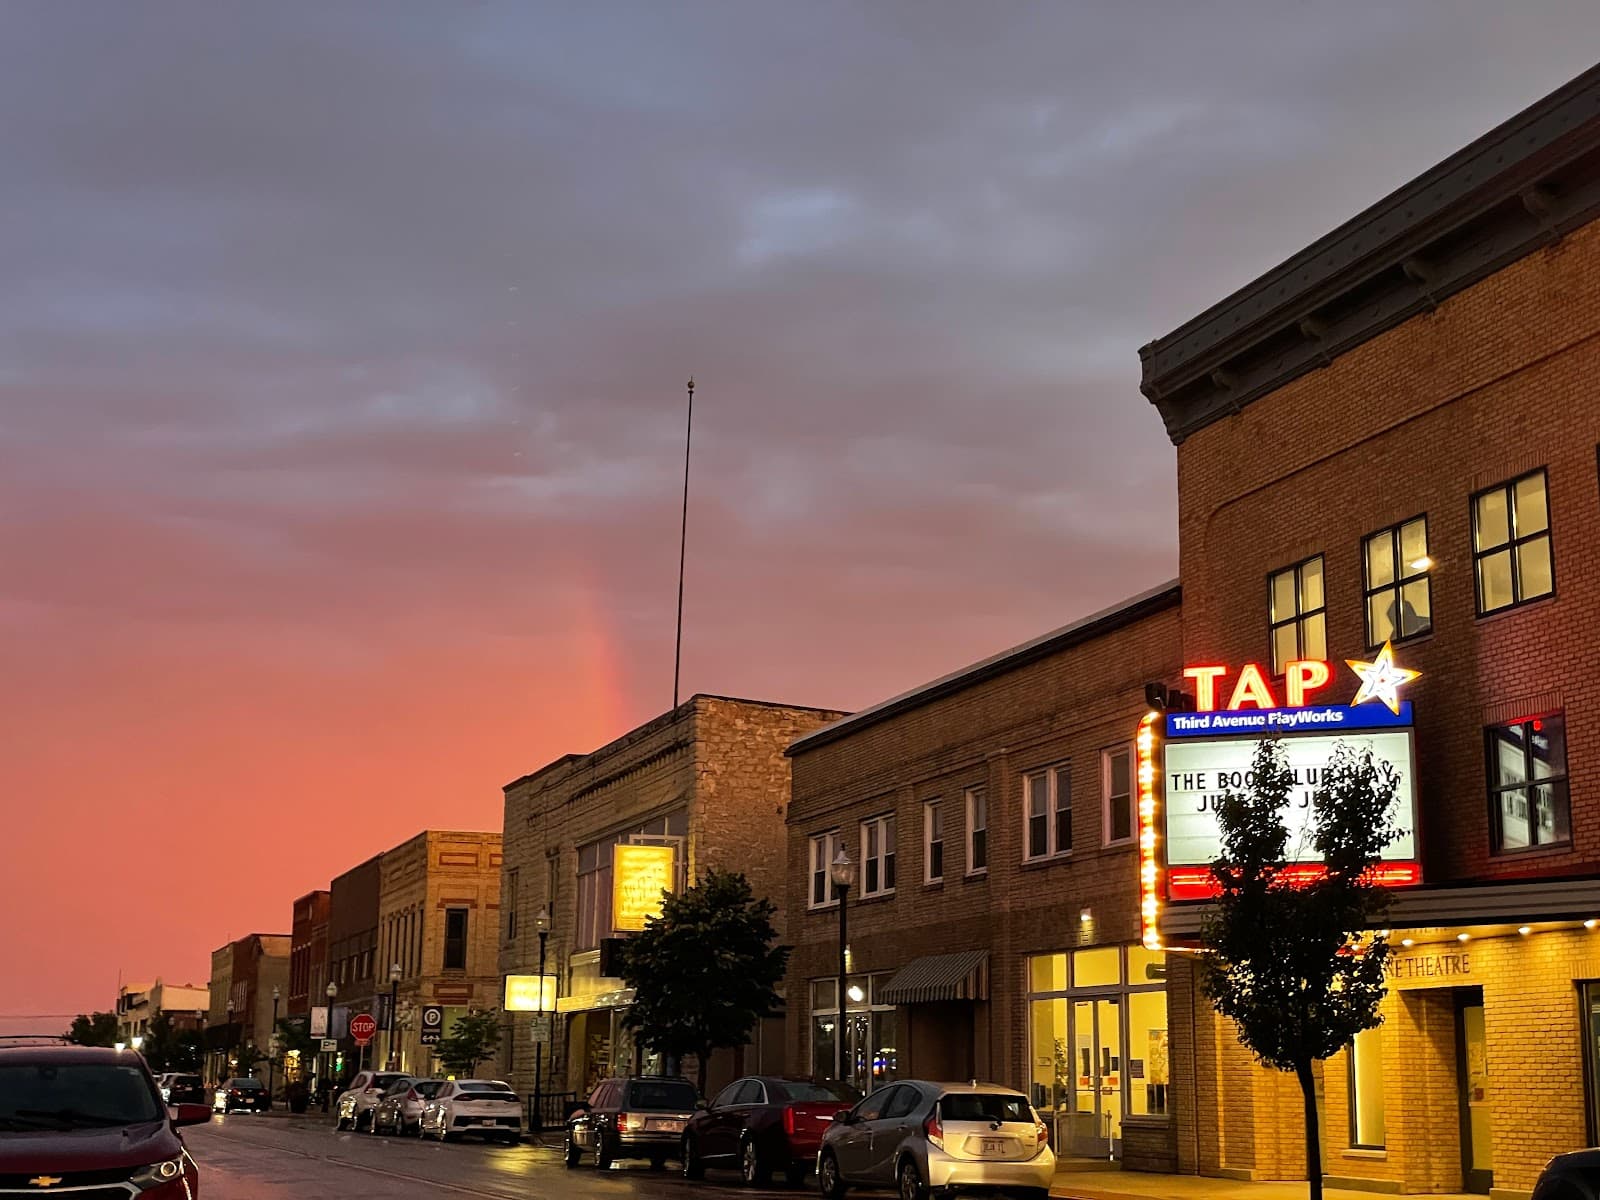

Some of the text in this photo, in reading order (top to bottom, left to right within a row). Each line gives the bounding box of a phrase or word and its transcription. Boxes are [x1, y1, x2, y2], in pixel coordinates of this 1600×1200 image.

[1184, 660, 1331, 712] TAP
[1173, 709, 1343, 730] Third Avenue PlayWorks
[1171, 773, 1206, 791] THE
[1217, 770, 1266, 789] BOO
[1405, 954, 1470, 977] THEATRE
[352, 1021, 375, 1033] STOP
